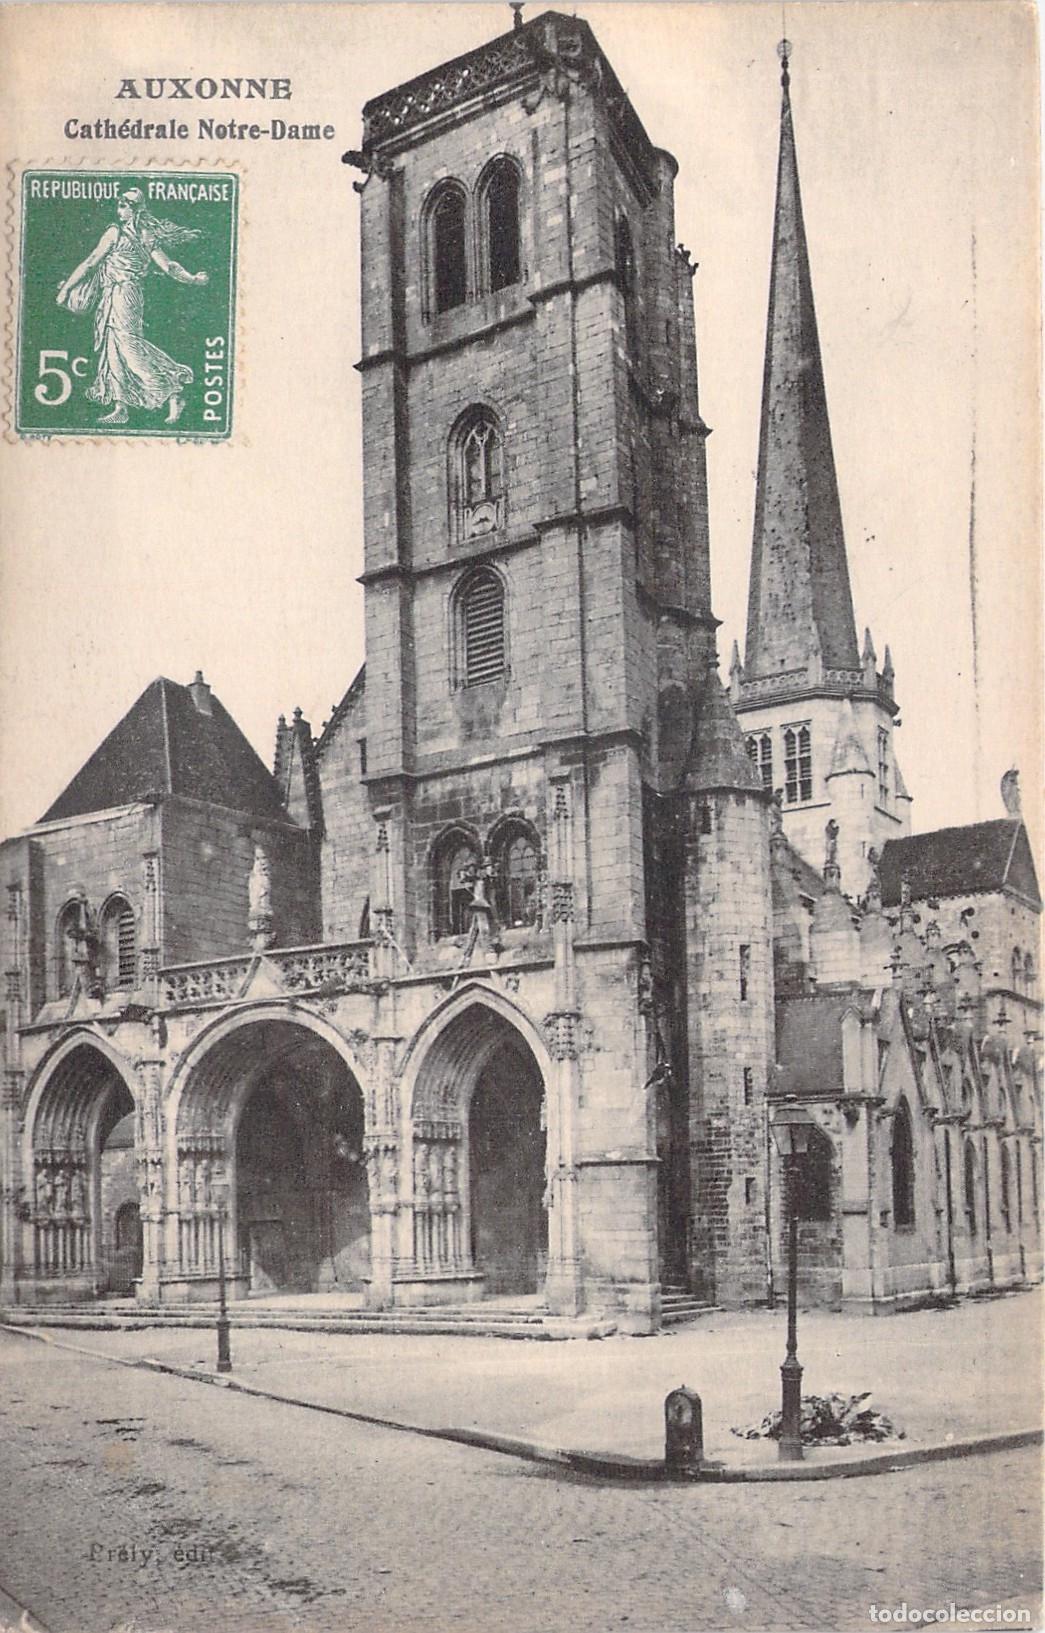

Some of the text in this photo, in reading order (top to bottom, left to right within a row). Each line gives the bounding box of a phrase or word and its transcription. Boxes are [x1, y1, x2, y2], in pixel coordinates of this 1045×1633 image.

[30, 180, 229, 203] REPUBLIQUE FRANÇAISE
[204, 336, 225, 422] POSTES
